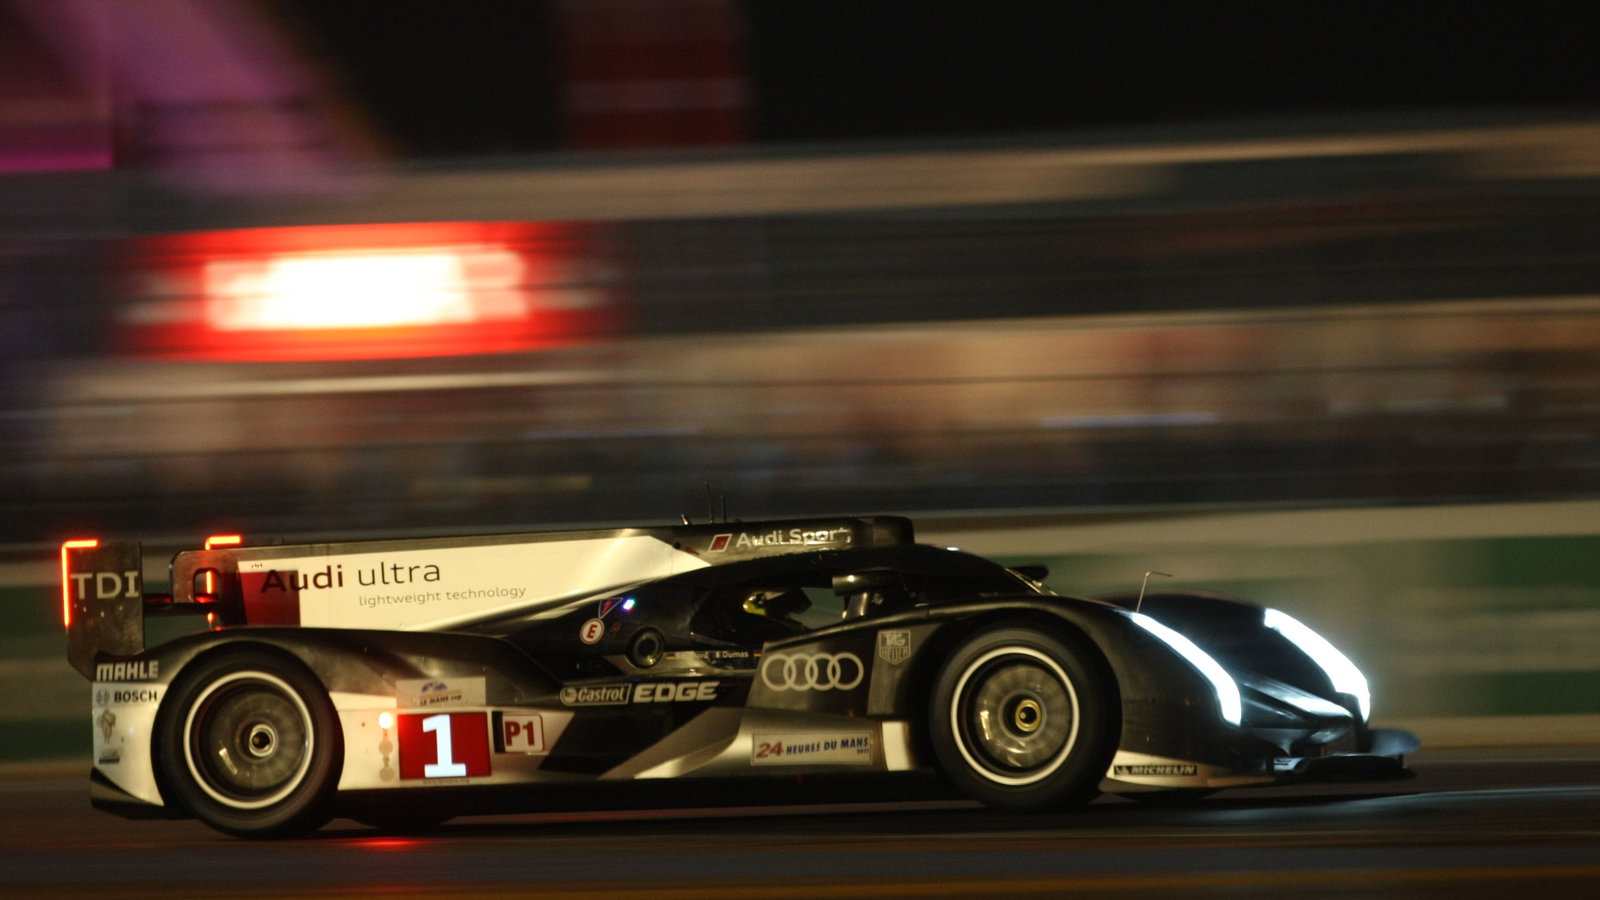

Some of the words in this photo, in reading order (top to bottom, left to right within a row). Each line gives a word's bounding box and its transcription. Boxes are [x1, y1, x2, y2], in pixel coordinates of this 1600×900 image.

[736, 530, 783, 548] Audi
[70, 571, 139, 600] TDI
[261, 564, 344, 593] Audi
[357, 562, 441, 586] ultra
[358, 591, 442, 608] lightweight
[446, 586, 527, 601] technology
[586, 624, 598, 639] E
[96, 661, 160, 682] MAHLE
[113, 690, 158, 703] BOSCH
[577, 684, 625, 702] Castrol
[633, 681, 720, 703] EDGE
[504, 721, 535, 747] P1
[422, 714, 467, 778] 1
[756, 741, 784, 758] 24
[786, 743, 820, 755] HEURES
[824, 740, 837, 750] DU
[840, 737, 869, 748] MANS
[1131, 765, 1195, 775] MICHELIN
